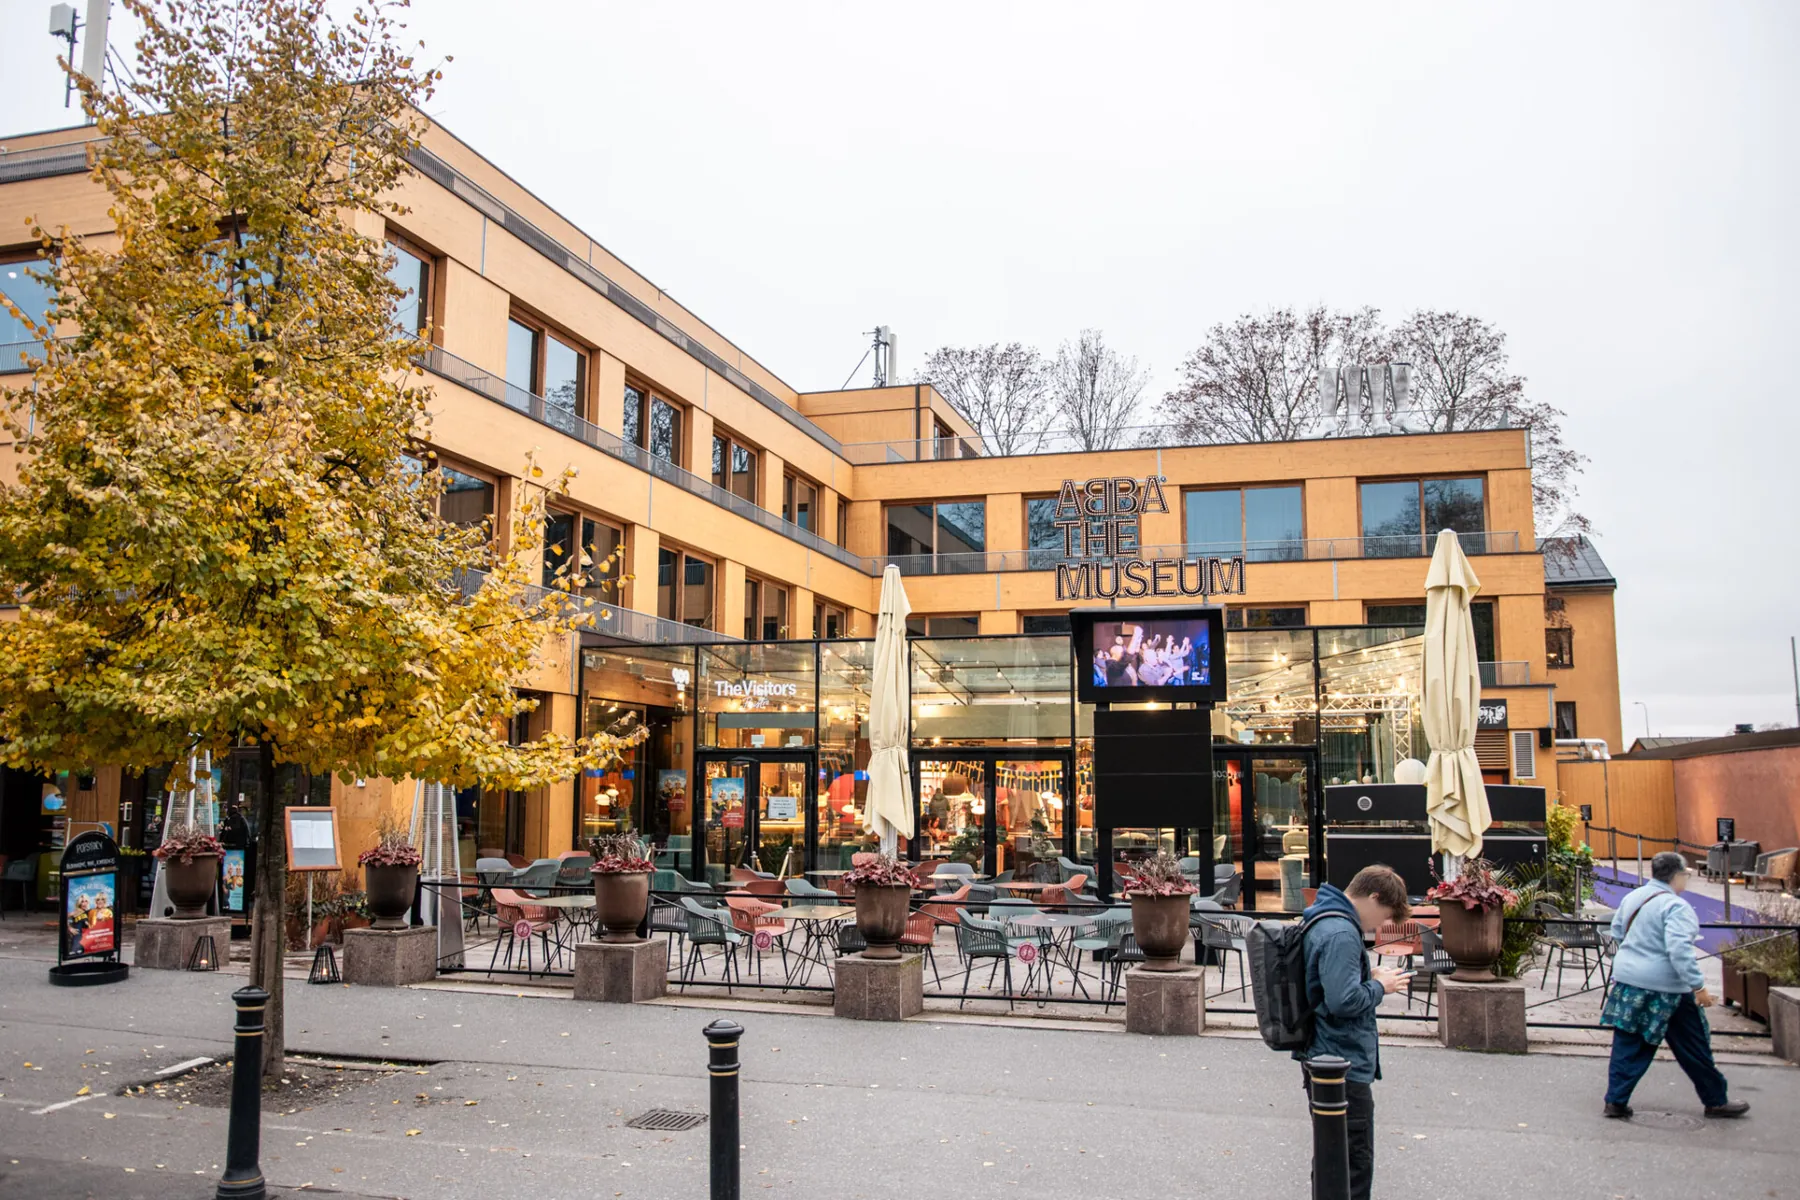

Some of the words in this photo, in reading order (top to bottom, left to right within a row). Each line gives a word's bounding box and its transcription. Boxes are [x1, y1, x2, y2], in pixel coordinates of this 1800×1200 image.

[1055, 475, 1169, 518] ABBA
[1054, 518, 1138, 559] THE
[1055, 555, 1246, 601] MUSEUM
